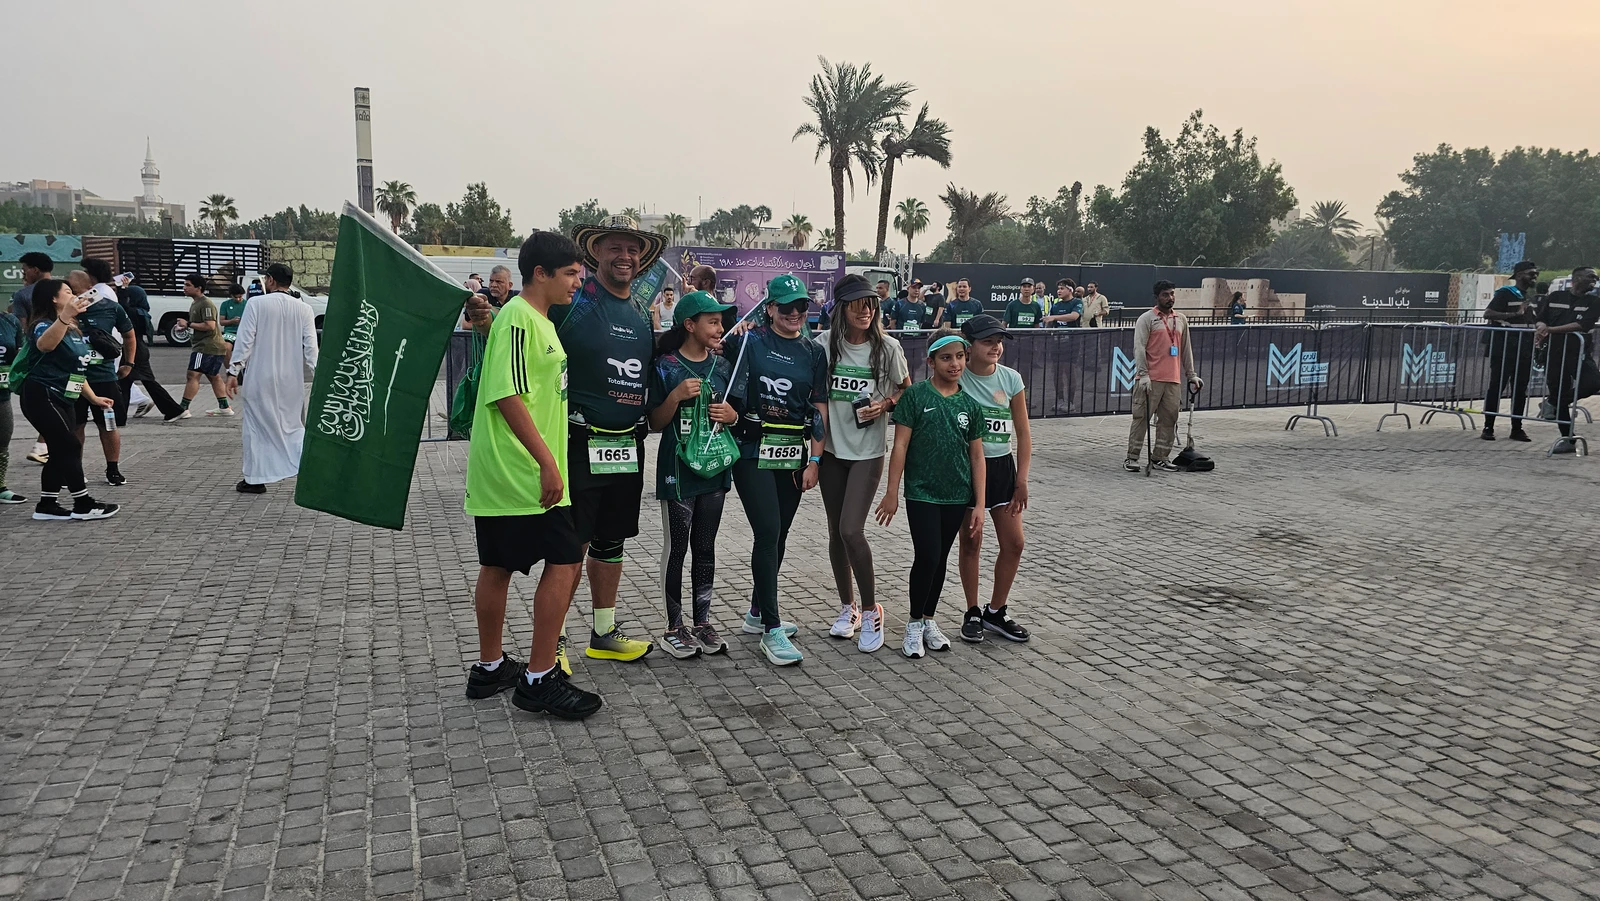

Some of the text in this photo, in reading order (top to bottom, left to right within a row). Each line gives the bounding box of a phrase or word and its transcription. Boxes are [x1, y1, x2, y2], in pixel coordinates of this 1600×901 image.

[991, 292, 1008, 302] Bab
[1362, 295, 1410, 309] باب المدينة
[607, 377, 643, 389] TotalEnergies
[832, 376, 869, 392] 1502
[608, 390, 643, 401] QUARTZ
[985, 419, 1007, 433] 501
[596, 448, 631, 462] 1665
[767, 446, 797, 458] 1658
